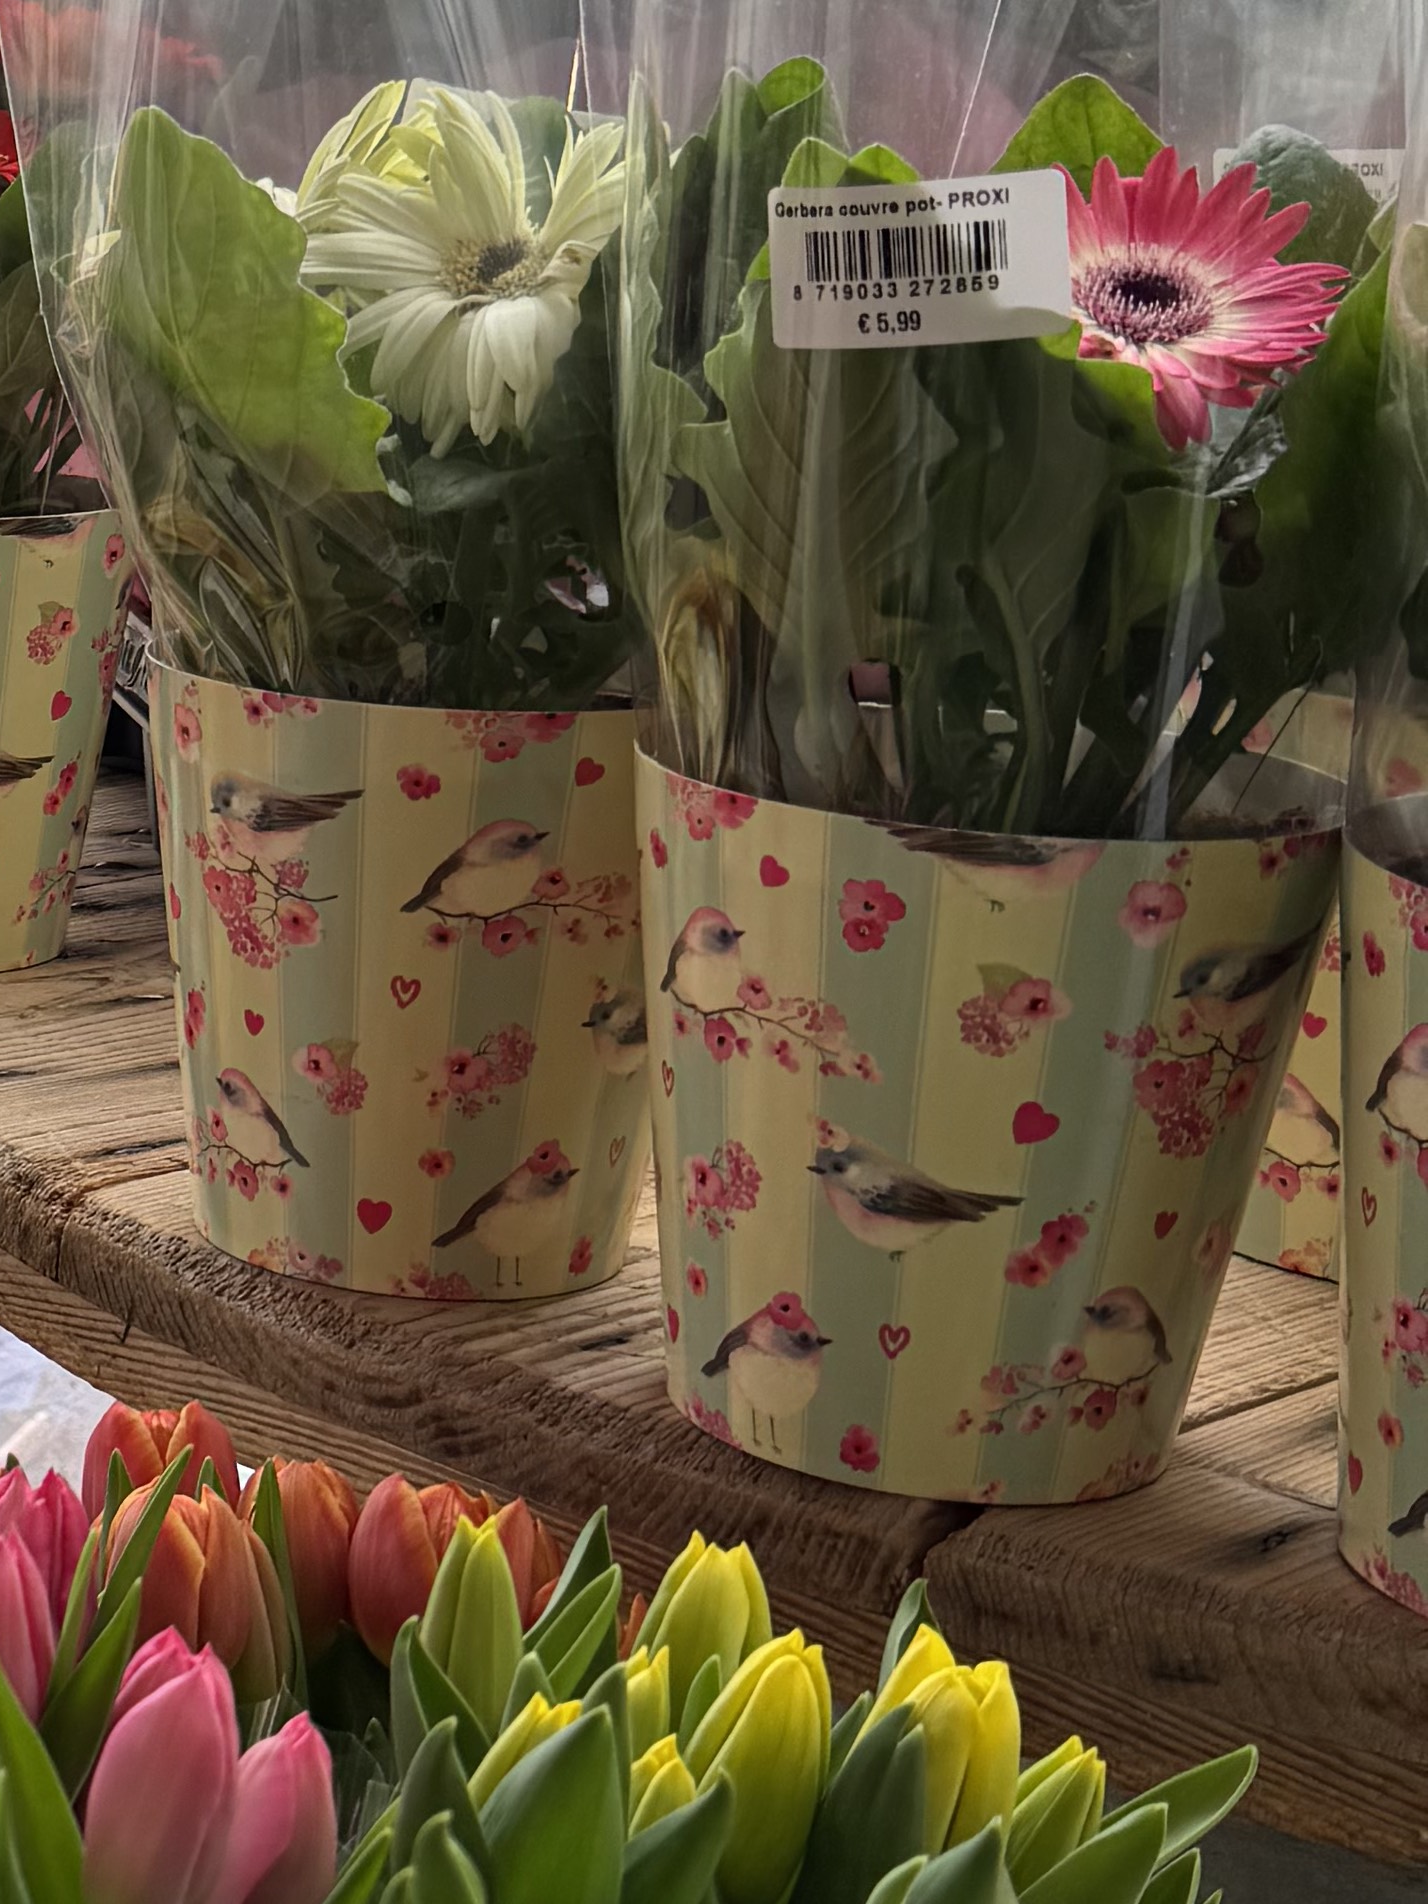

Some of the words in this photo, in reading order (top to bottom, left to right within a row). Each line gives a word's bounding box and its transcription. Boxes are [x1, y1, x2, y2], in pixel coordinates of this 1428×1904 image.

[774, 201, 834, 219] Gerbera
[839, 200, 900, 217] couvre
[947, 187, 1010, 210] PROXI
[793, 284, 803, 301] 8
[815, 281, 899, 302] 719033
[908, 274, 1000, 298] 272859
[876, 309, 922, 334] 5,99
